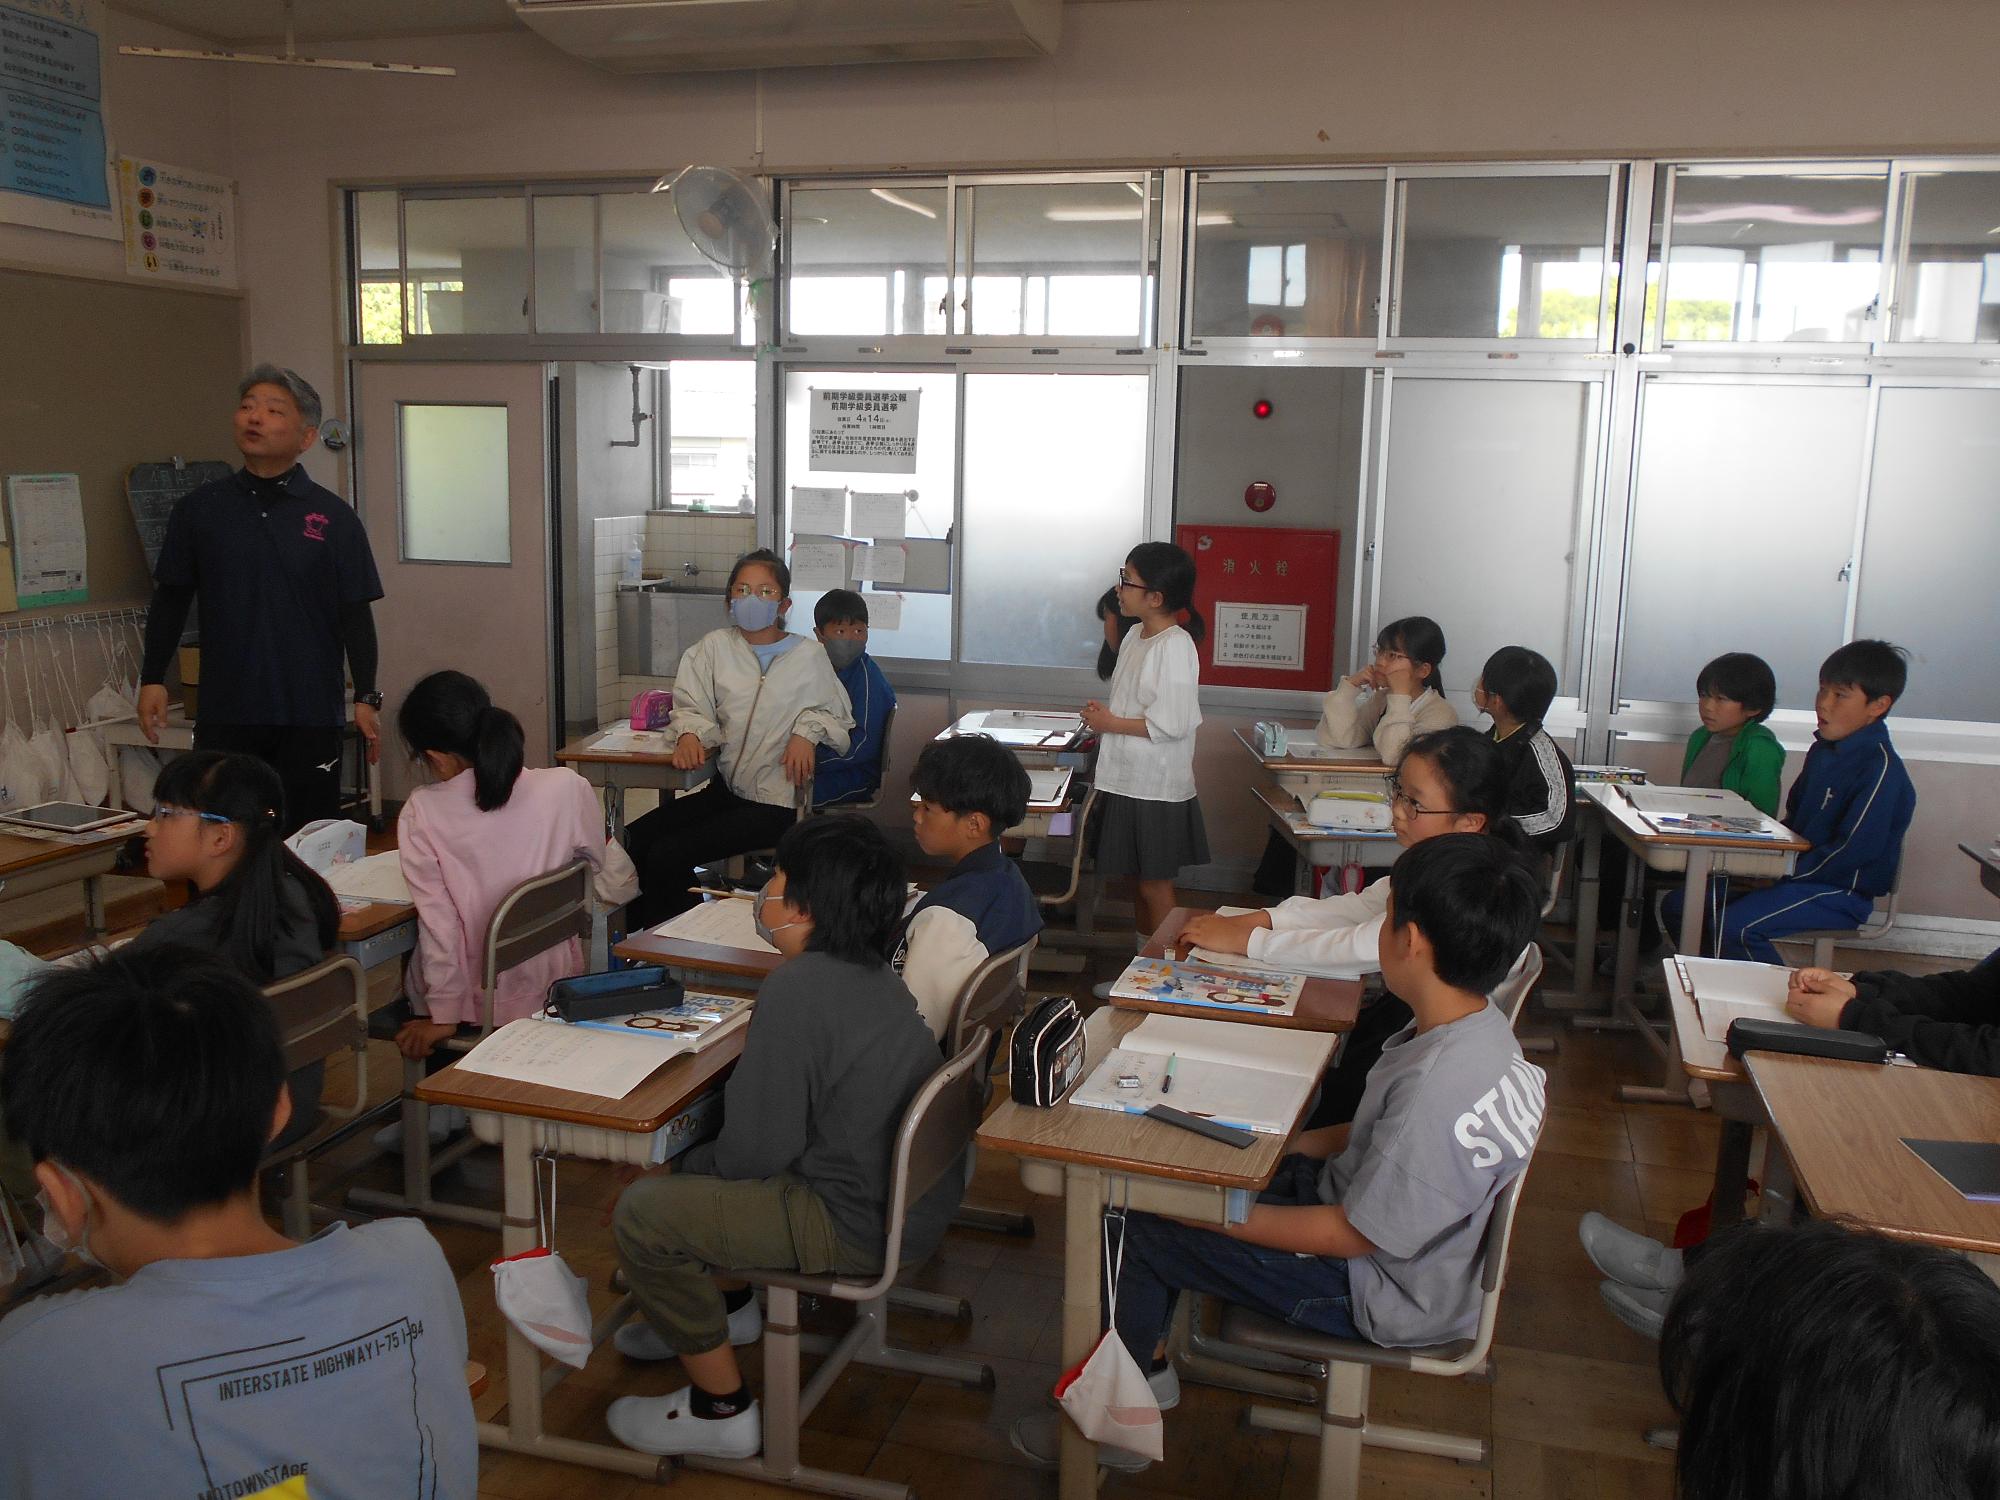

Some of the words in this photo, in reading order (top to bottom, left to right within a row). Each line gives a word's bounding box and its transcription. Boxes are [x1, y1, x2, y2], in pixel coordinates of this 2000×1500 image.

[823, 392, 907, 402] 前期学級委員選挙公報
[831, 402, 898, 411] 前期学級委員選挙
[1223, 558, 1288, 577] 消火栓
[1240, 612, 1280, 622] 使用方法
[219, 1364, 310, 1401] INTERSTATE
[314, 1343, 373, 1379] HIGHWAY
